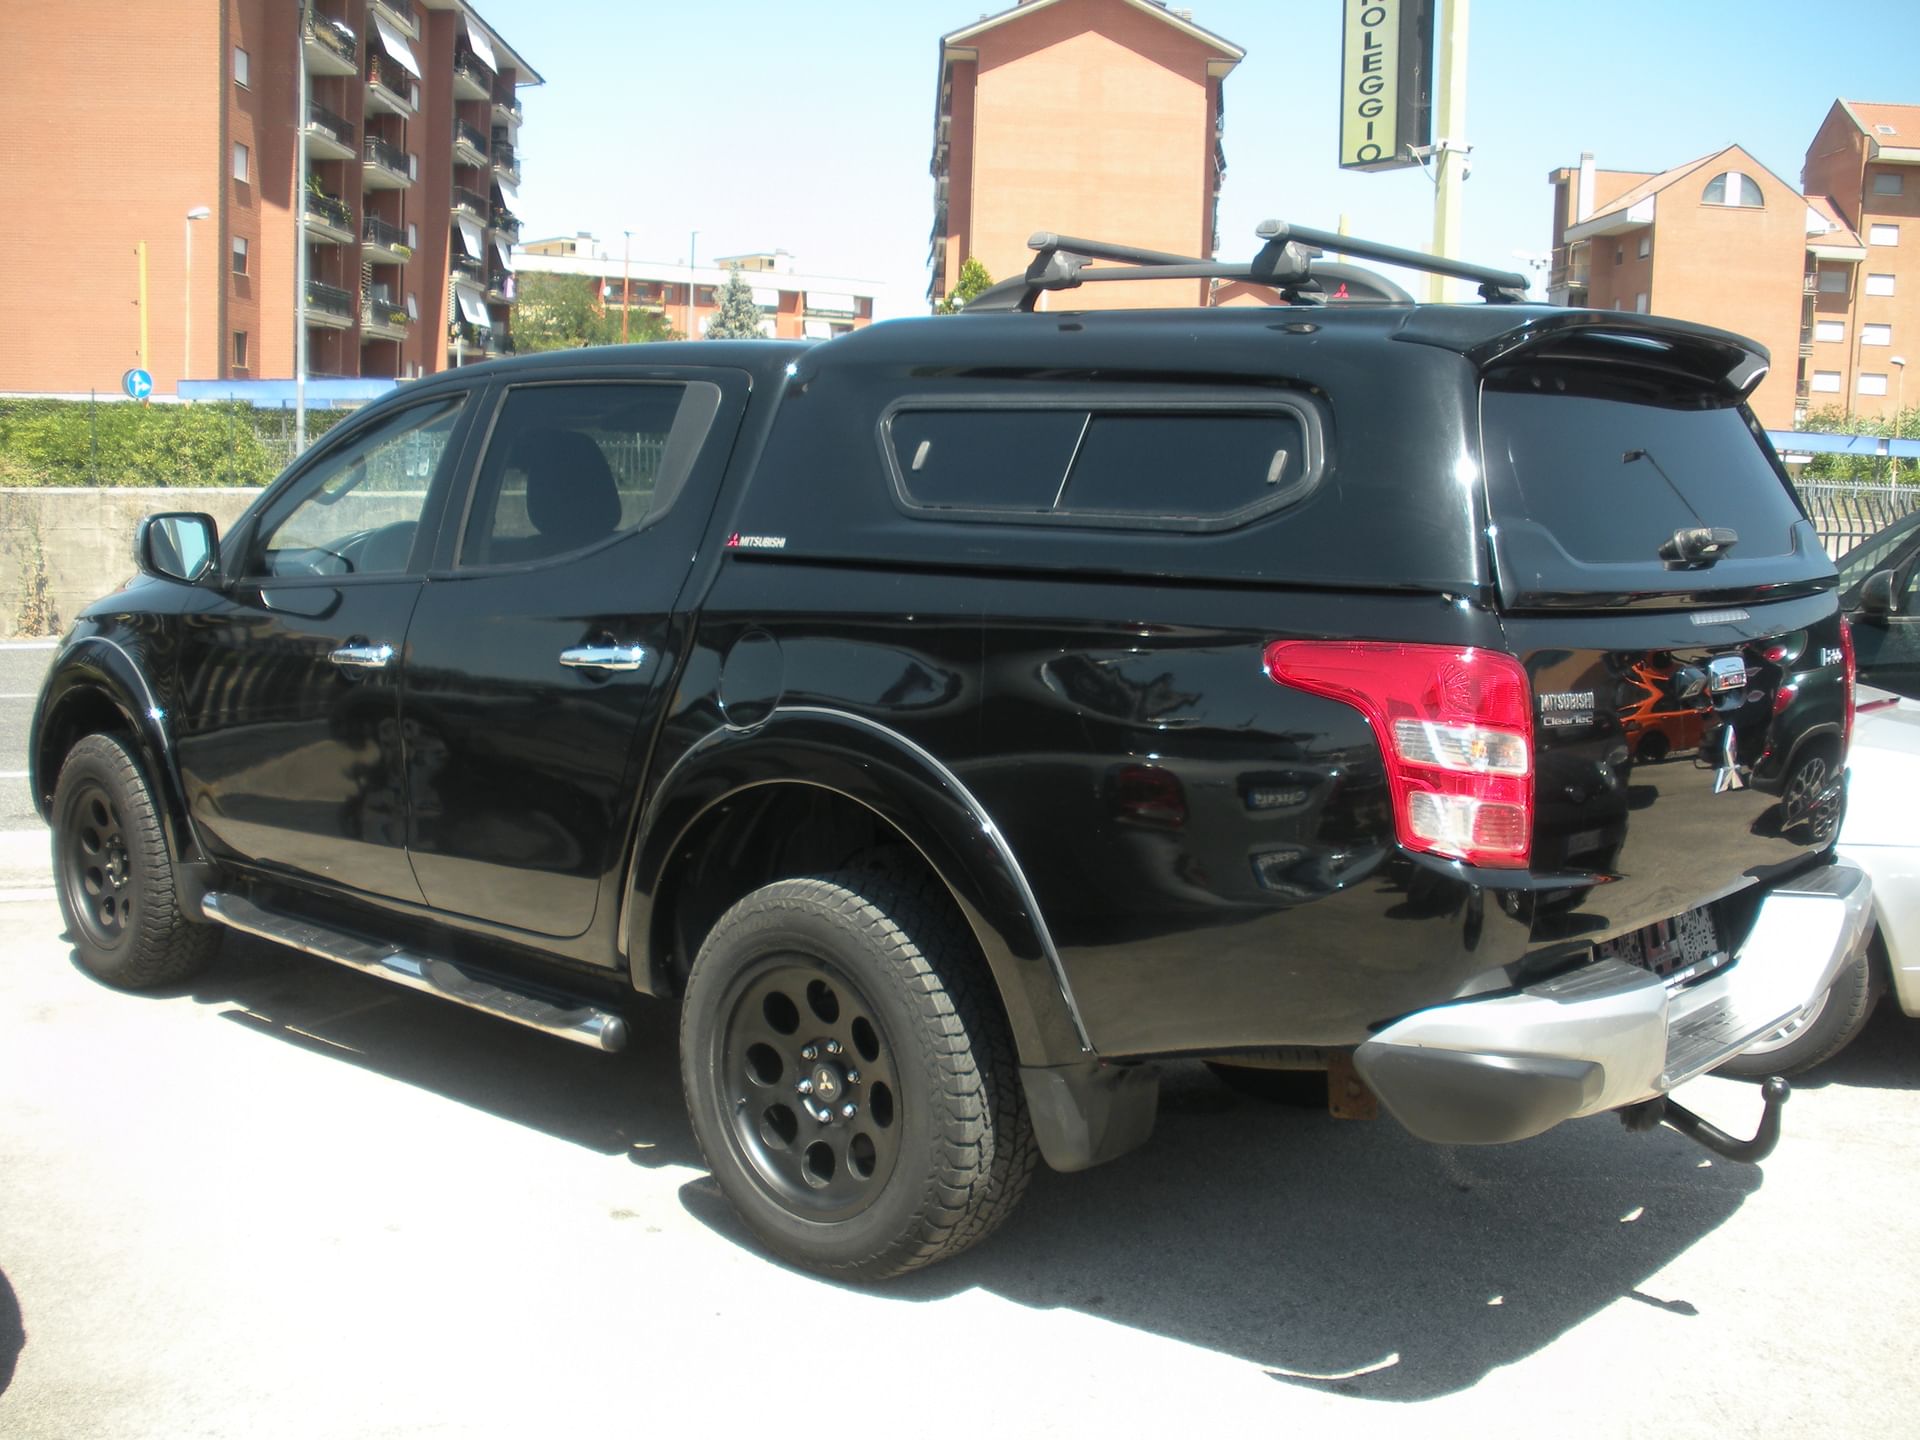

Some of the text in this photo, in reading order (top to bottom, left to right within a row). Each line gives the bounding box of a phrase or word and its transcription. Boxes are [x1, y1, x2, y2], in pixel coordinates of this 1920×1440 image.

[1357, 0, 1386, 162] OLEGGIO
[739, 535, 786, 548] MITSUBISHI
[1540, 691, 1594, 712] MITSUBISHI
